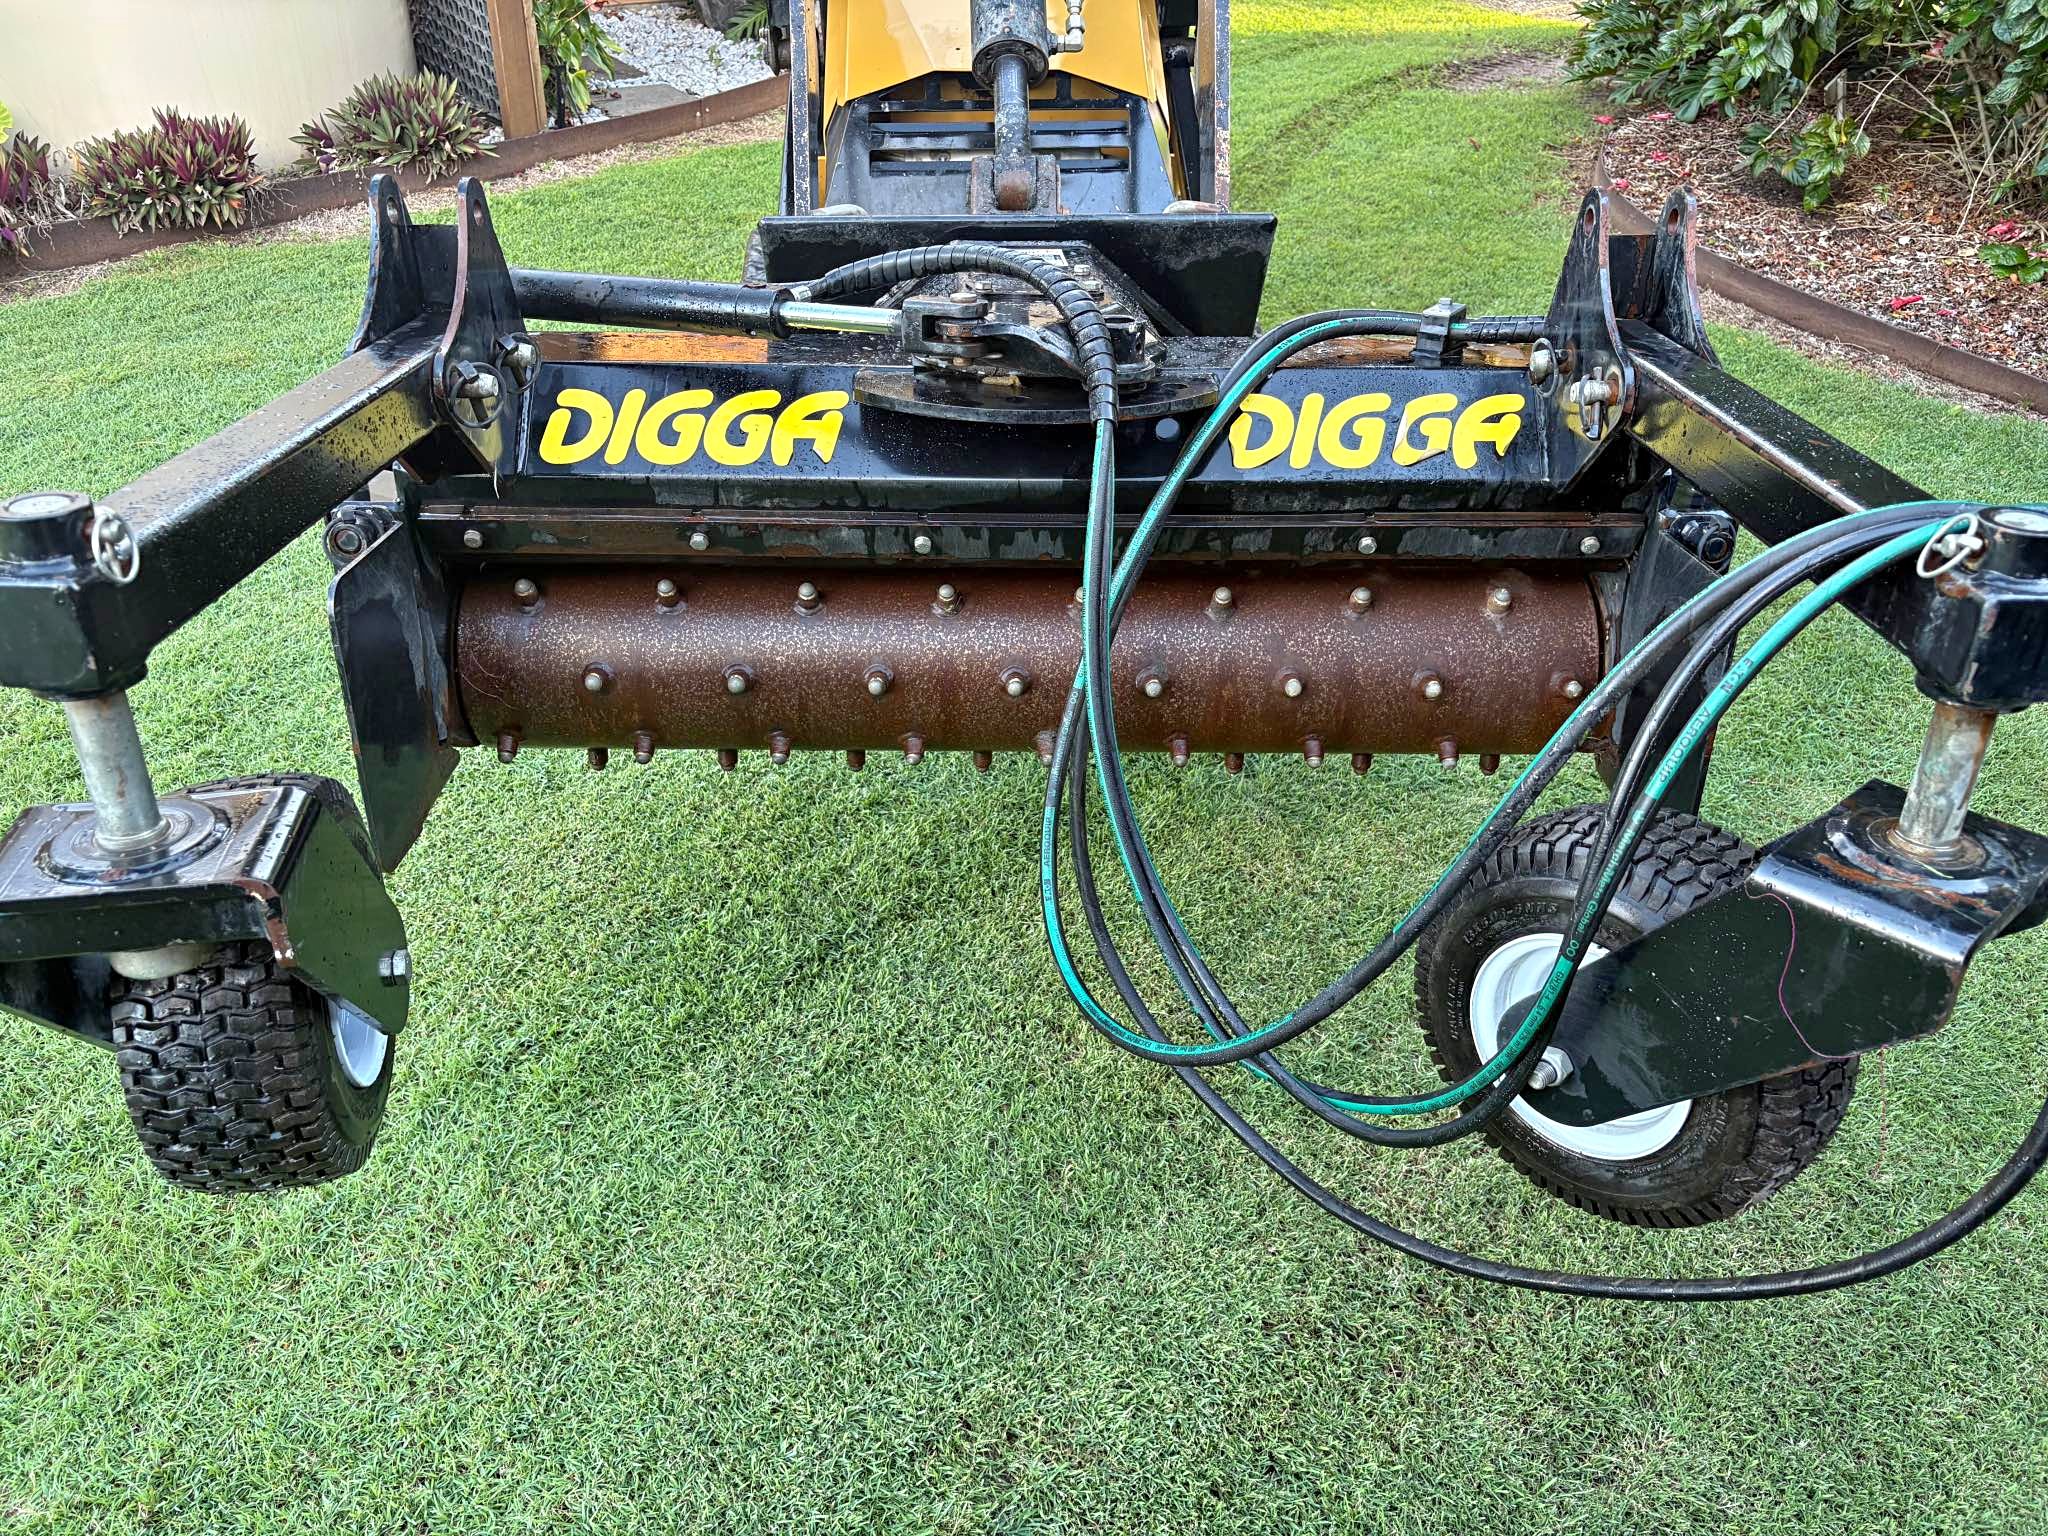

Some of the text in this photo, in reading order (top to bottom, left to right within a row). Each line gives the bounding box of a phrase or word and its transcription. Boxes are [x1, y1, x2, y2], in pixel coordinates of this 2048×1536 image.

[539, 388, 848, 466] DIGGA
[1229, 392, 1526, 470] DIGGA
[1654, 705, 1713, 784] AEROQUIP
